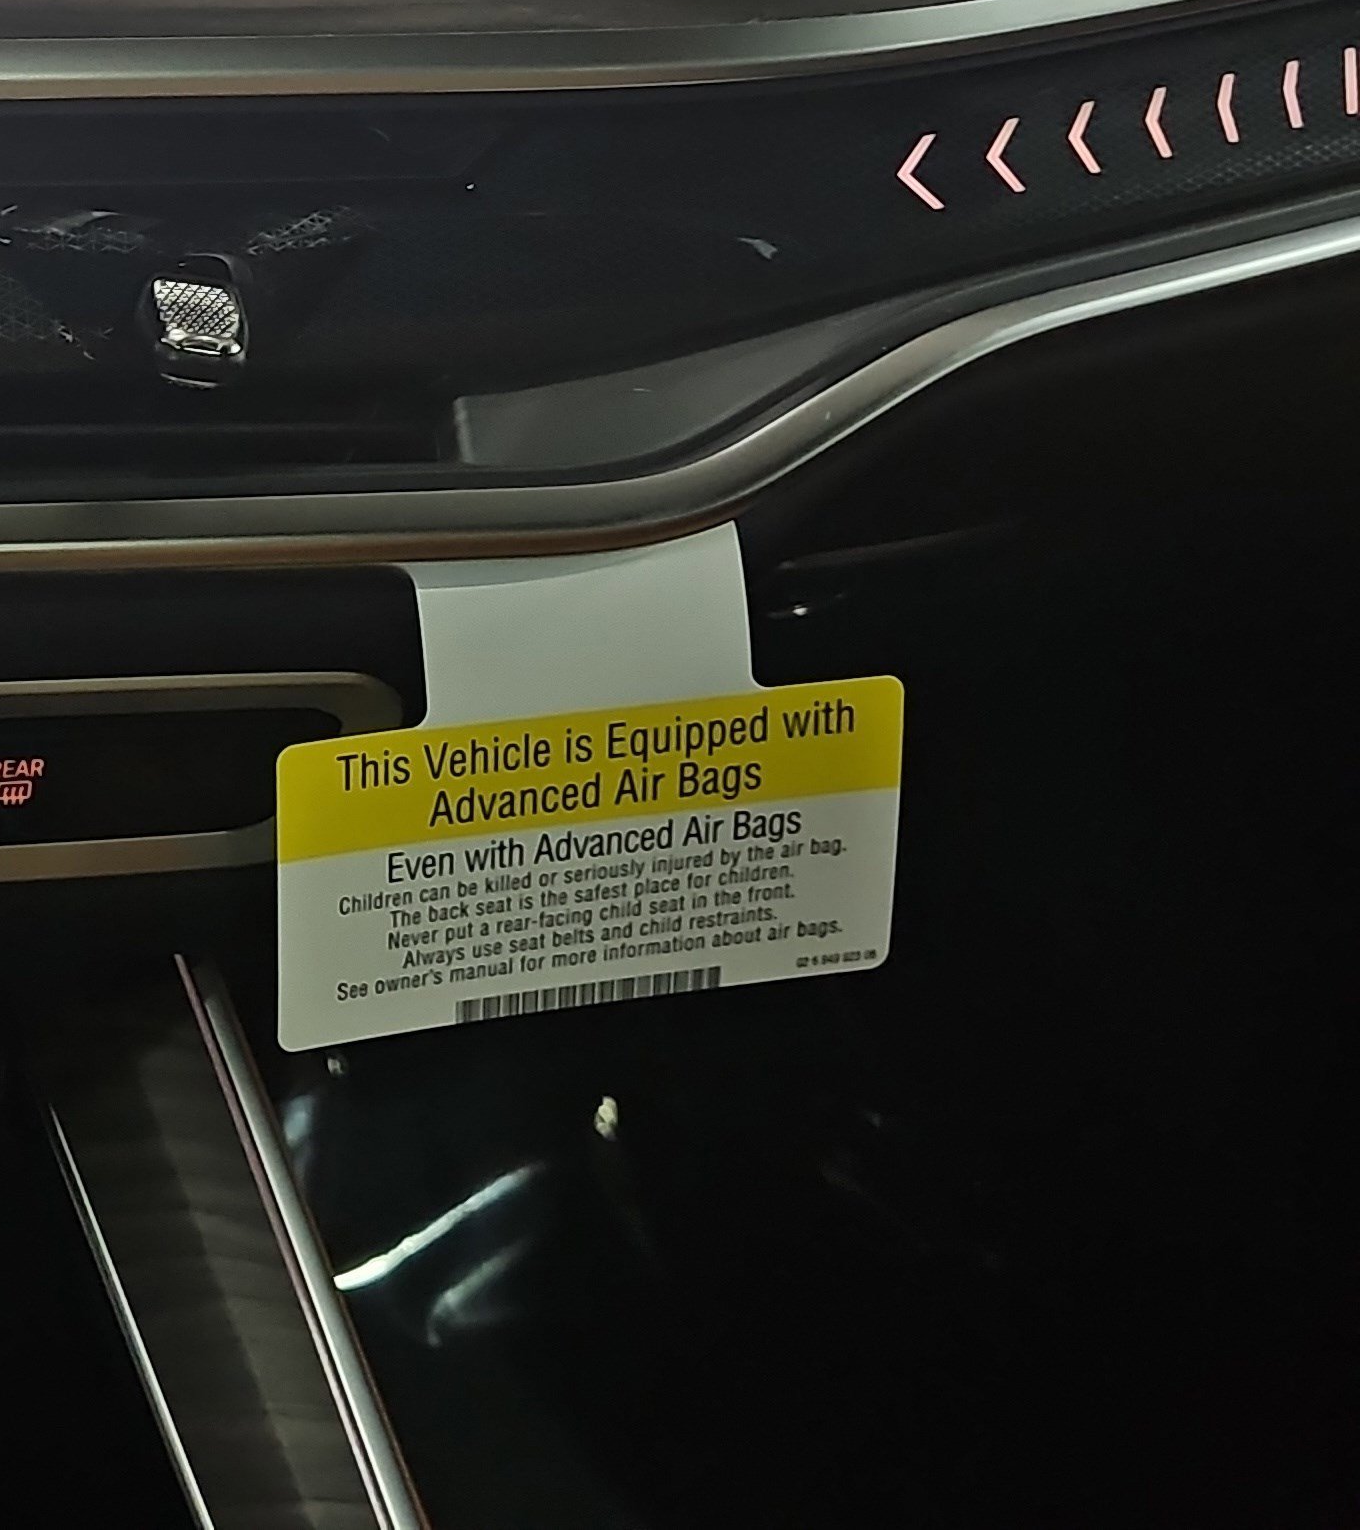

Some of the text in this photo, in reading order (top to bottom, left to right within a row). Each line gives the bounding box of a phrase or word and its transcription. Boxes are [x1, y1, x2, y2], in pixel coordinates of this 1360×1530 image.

[336, 699, 854, 791] This Vehicle is Equipped with
[430, 762, 761, 827] Advanced Air Bags
[339, 838, 847, 915] Children can be killed or seriously injured by the air bag.
[388, 811, 801, 883] Even with Advanced Air Bags
[388, 883, 794, 950] Never put a rear-facing child seat in the front.
[390, 865, 794, 928] The back seat is the safest place for children.
[337, 920, 842, 1001] See owner's manual for more information about air bags.
[402, 907, 777, 969] Always use seat belts and child restraints.
